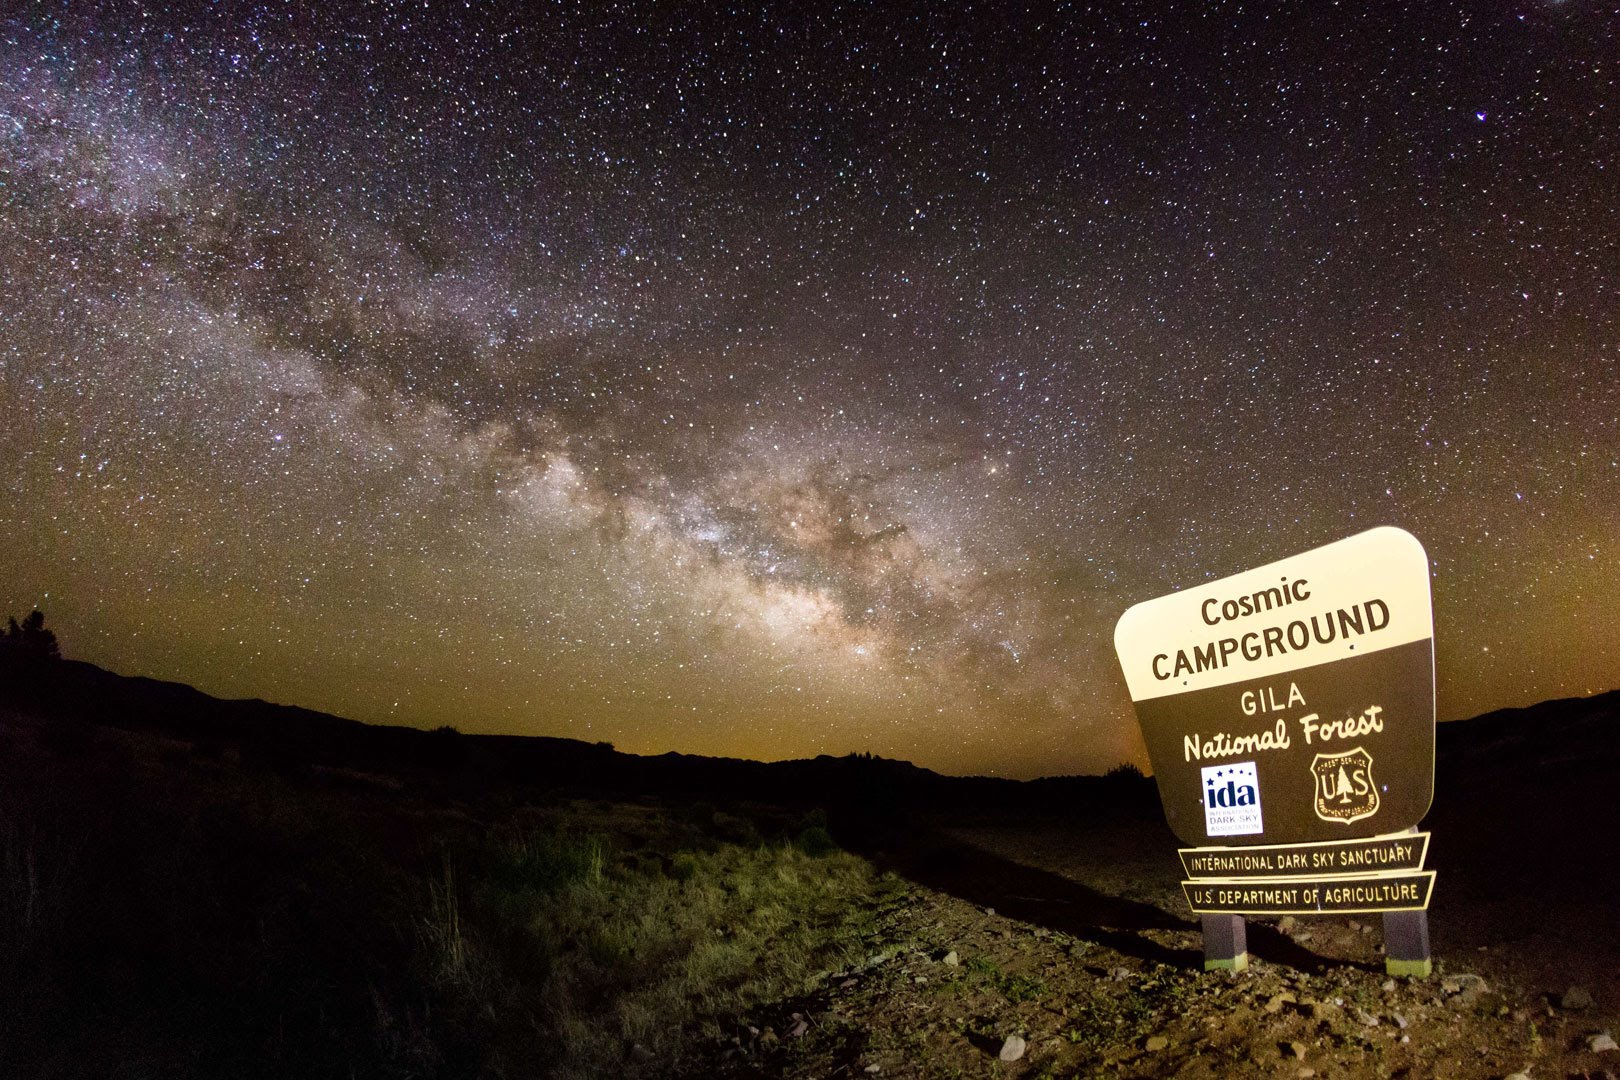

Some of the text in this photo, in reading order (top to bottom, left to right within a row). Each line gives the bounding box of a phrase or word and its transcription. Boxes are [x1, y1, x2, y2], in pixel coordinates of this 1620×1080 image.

[1201, 576, 1311, 626] Cosmic
[1152, 598, 1390, 681] CAMPGROUND
[1241, 682, 1306, 716] GILA
[1184, 705, 1384, 762] National Forest
[1207, 779, 1256, 809] ida
[1191, 846, 1412, 871] INTERNATIONAL DARK SKY SANCTUARY
[1194, 884, 1419, 905] U.S. DEPARTMENT OF AGRICULTURE
